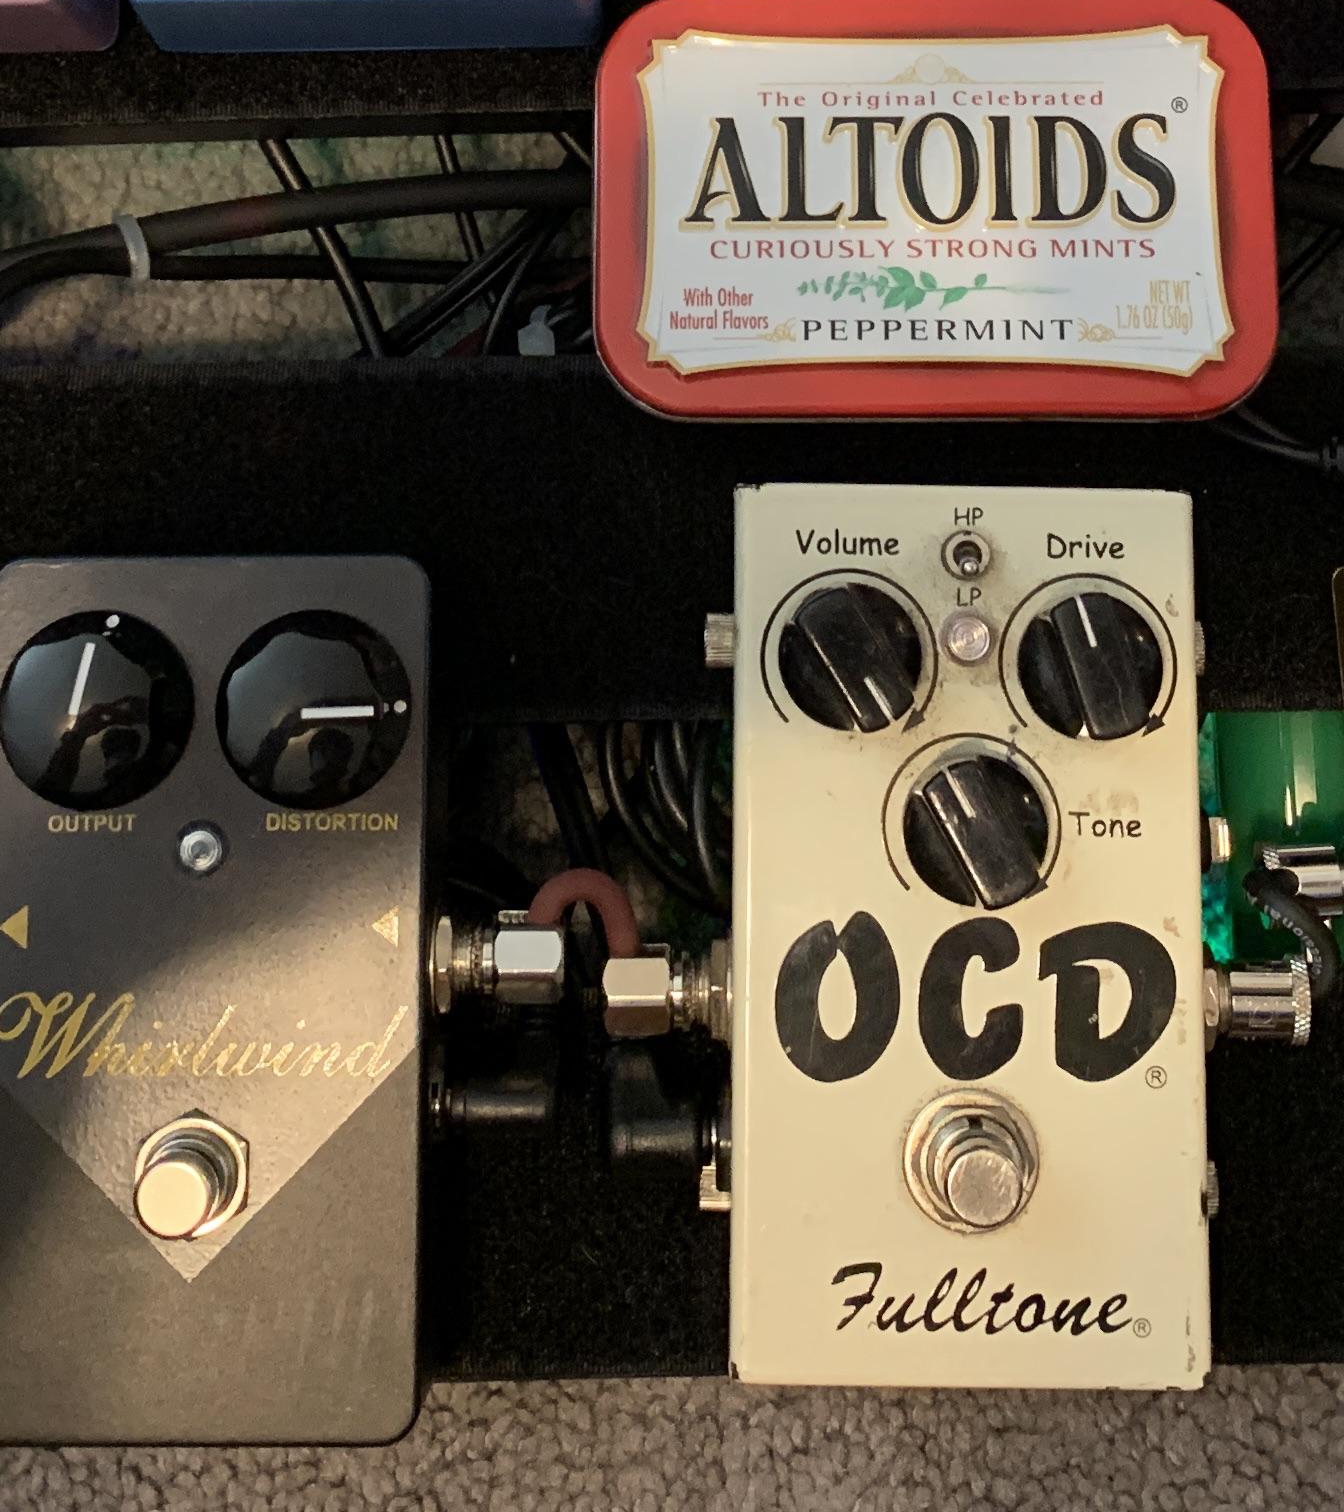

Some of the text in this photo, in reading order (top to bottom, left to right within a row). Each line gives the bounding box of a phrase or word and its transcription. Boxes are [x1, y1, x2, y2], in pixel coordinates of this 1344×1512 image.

[757, 90, 1104, 110] The Original Celebrated
[682, 112, 1176, 226] ALTOIDS
[710, 238, 1155, 260] CURIOUSLY STRONG MINTS
[683, 288, 754, 307] With Other
[669, 310, 769, 330] Natural Flavors
[802, 318, 1074, 342] PEPPERMINT
[954, 507, 984, 526] HP
[795, 529, 900, 556] Volume
[1046, 533, 1125, 559] Drive
[956, 589, 982, 606] LP
[48, 812, 399, 833] OUTPUT DISTORTION
[1068, 811, 1142, 838] Tone
[774, 910, 1177, 1082] OCD
[831, 1261, 1133, 1336] Fulltone
